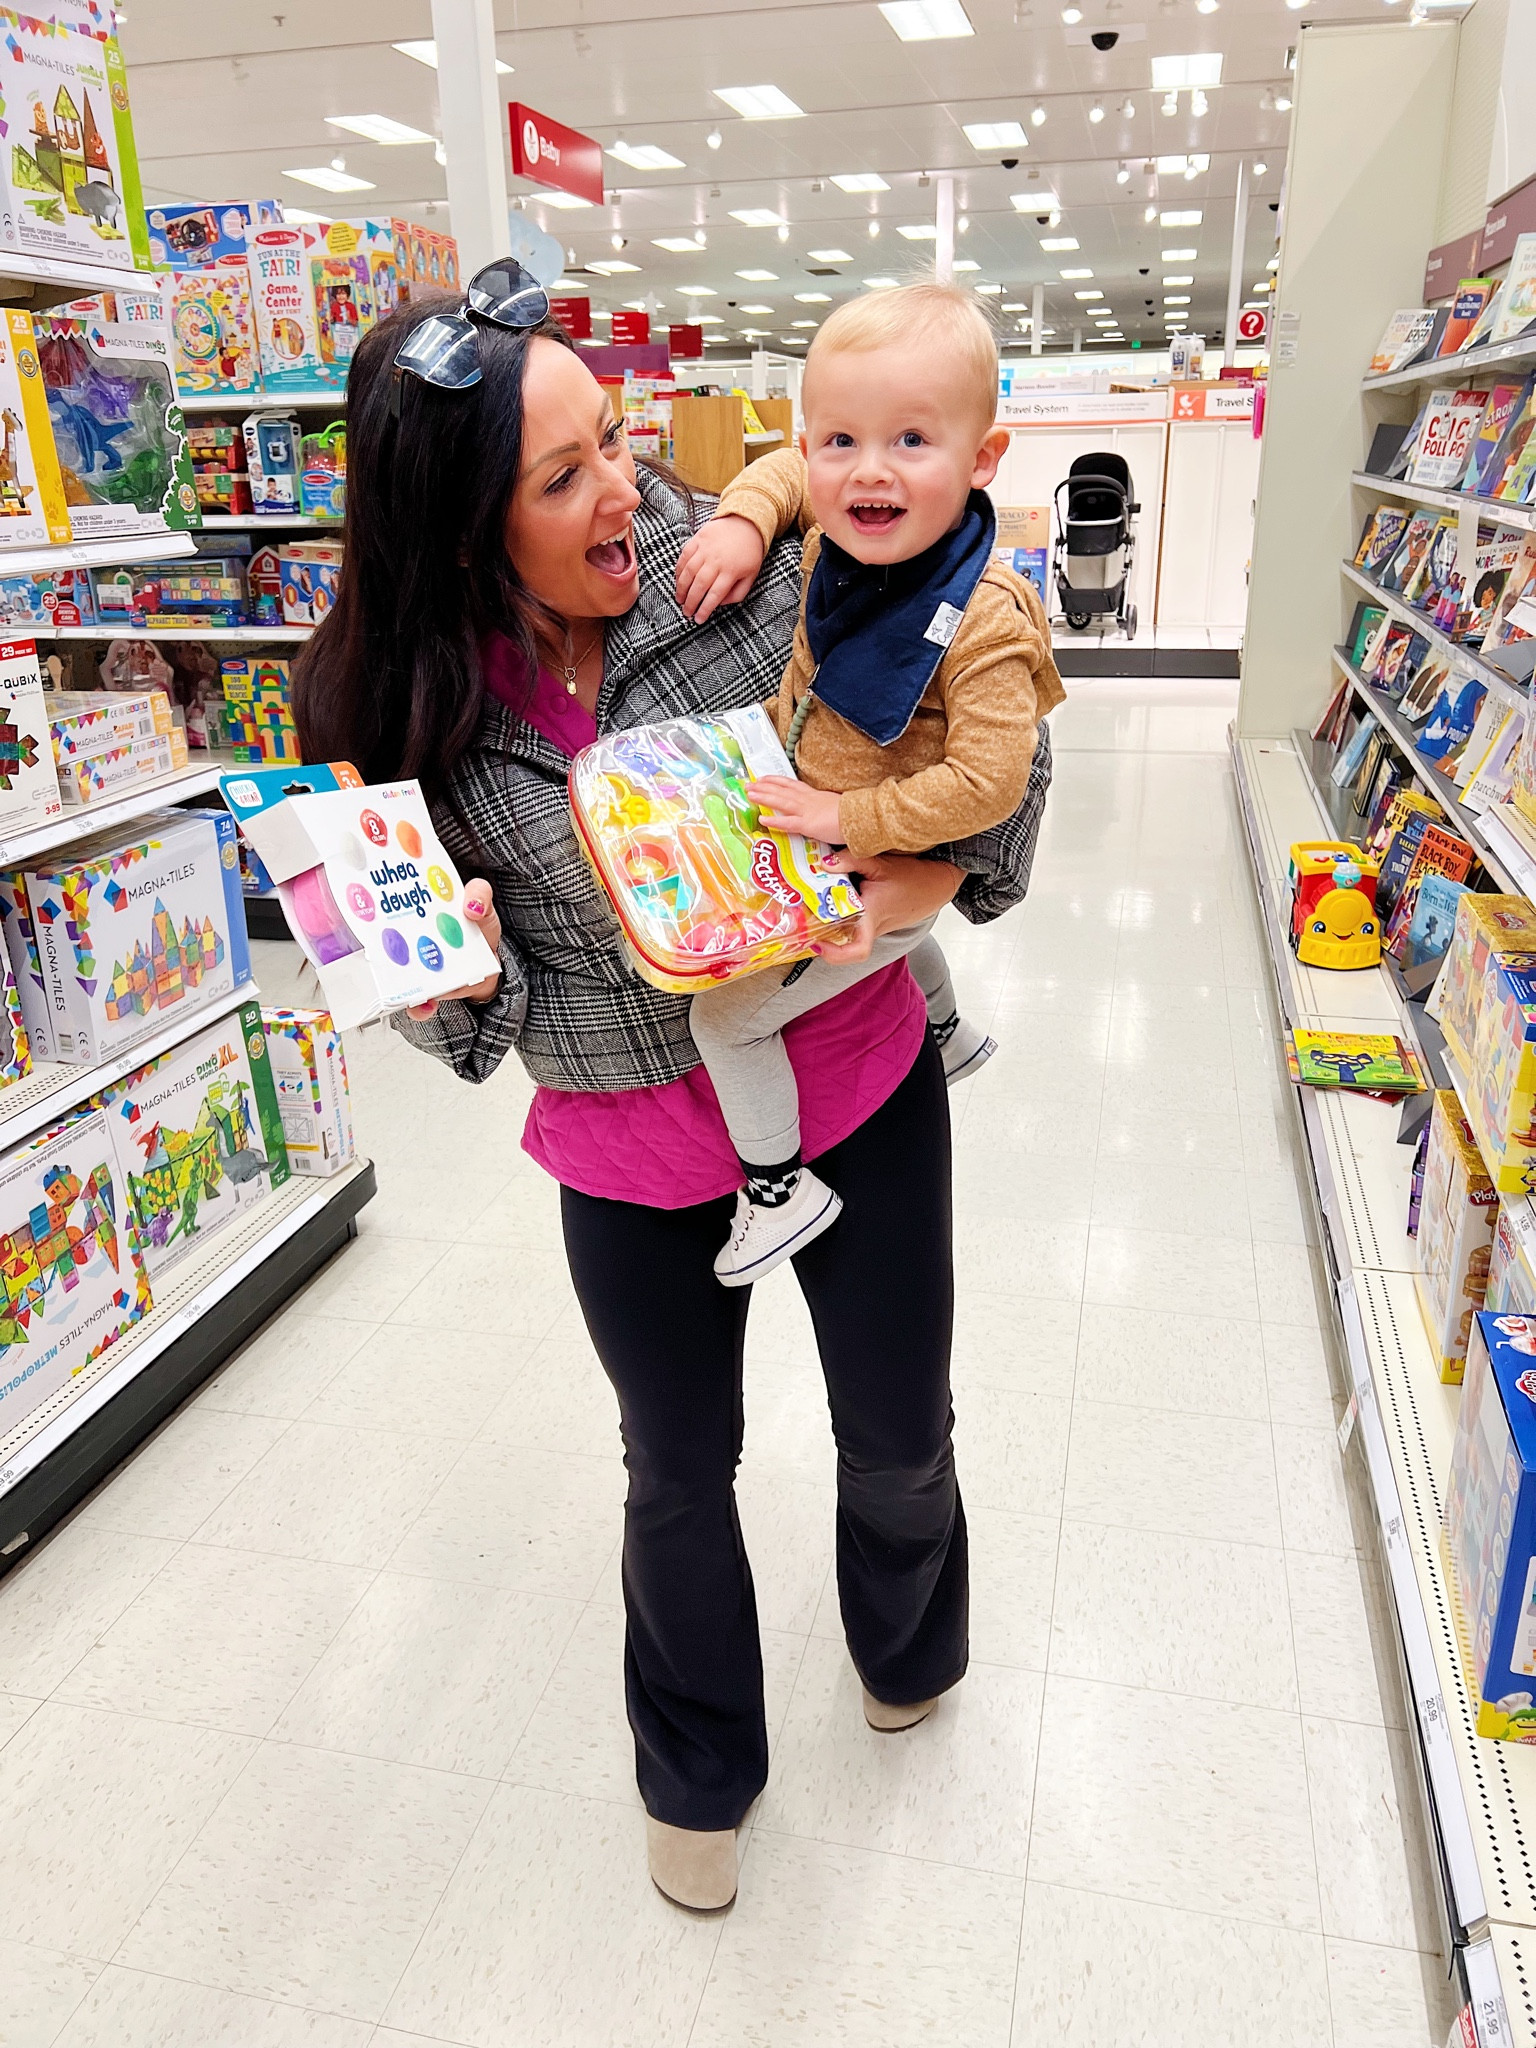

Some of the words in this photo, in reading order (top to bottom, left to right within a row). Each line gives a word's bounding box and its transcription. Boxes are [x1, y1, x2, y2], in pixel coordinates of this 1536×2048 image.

[108, 50, 120, 63] 25
[24, 52, 75, 76] MAGNA-TILES
[76, 63, 104, 80] JUNGLE
[540, 136, 560, 166] Baby
[257, 251, 274, 261] FUN
[274, 249, 283, 258] AT
[284, 249, 301, 257] THE
[259, 258, 300, 278] FAIR!
[267, 283, 298, 295] Game
[265, 295, 302, 307] Center
[125, 305, 164, 321] FAIR!
[12, 315, 27, 329] 25
[106, 338, 145, 349] MAGNA-TILES
[1005, 404, 1031, 415] Travel
[1033, 404, 1069, 416] System
[1216, 397, 1245, 408] Travel
[1476, 554, 1495, 569] MORE
[44, 596, 55, 605] 25
[2, 646, 15, 658] 29
[155, 699, 166, 711] 25
[76, 731, 114, 747] MAGNA-TILES
[105, 766, 137, 782] MAGNA-TILES
[341, 775, 358, 790] 3+
[229, 783, 255, 798] CHUCKLE
[382, 791, 400, 799] Gluten
[45, 803, 61, 815] 3-99
[220, 820, 231, 831] 74
[368, 819, 380, 836] 8
[1421, 843, 1445, 867] BLACK
[369, 860, 419, 887] whoa
[754, 841, 796, 906] Play-Doh
[128, 863, 195, 902] MAGNA-TILES
[380, 881, 432, 918] dough
[1421, 887, 1439, 907] Born
[43, 926, 66, 1012] MAGNA-TILES
[245, 1010, 256, 1022] 50
[140, 1073, 196, 1114] MAGNA-TILES
[196, 1056, 218, 1076] DINO
[217, 1043, 239, 1070] XL
[199, 1066, 220, 1081] WORLD
[59, 1299, 114, 1349] MAGNA-TILES
[0, 1345, 58, 1399] METROPOLIS
[1425, 1698, 1438, 1722] 20.99
[1483, 2000, 1499, 2036] 21.99
